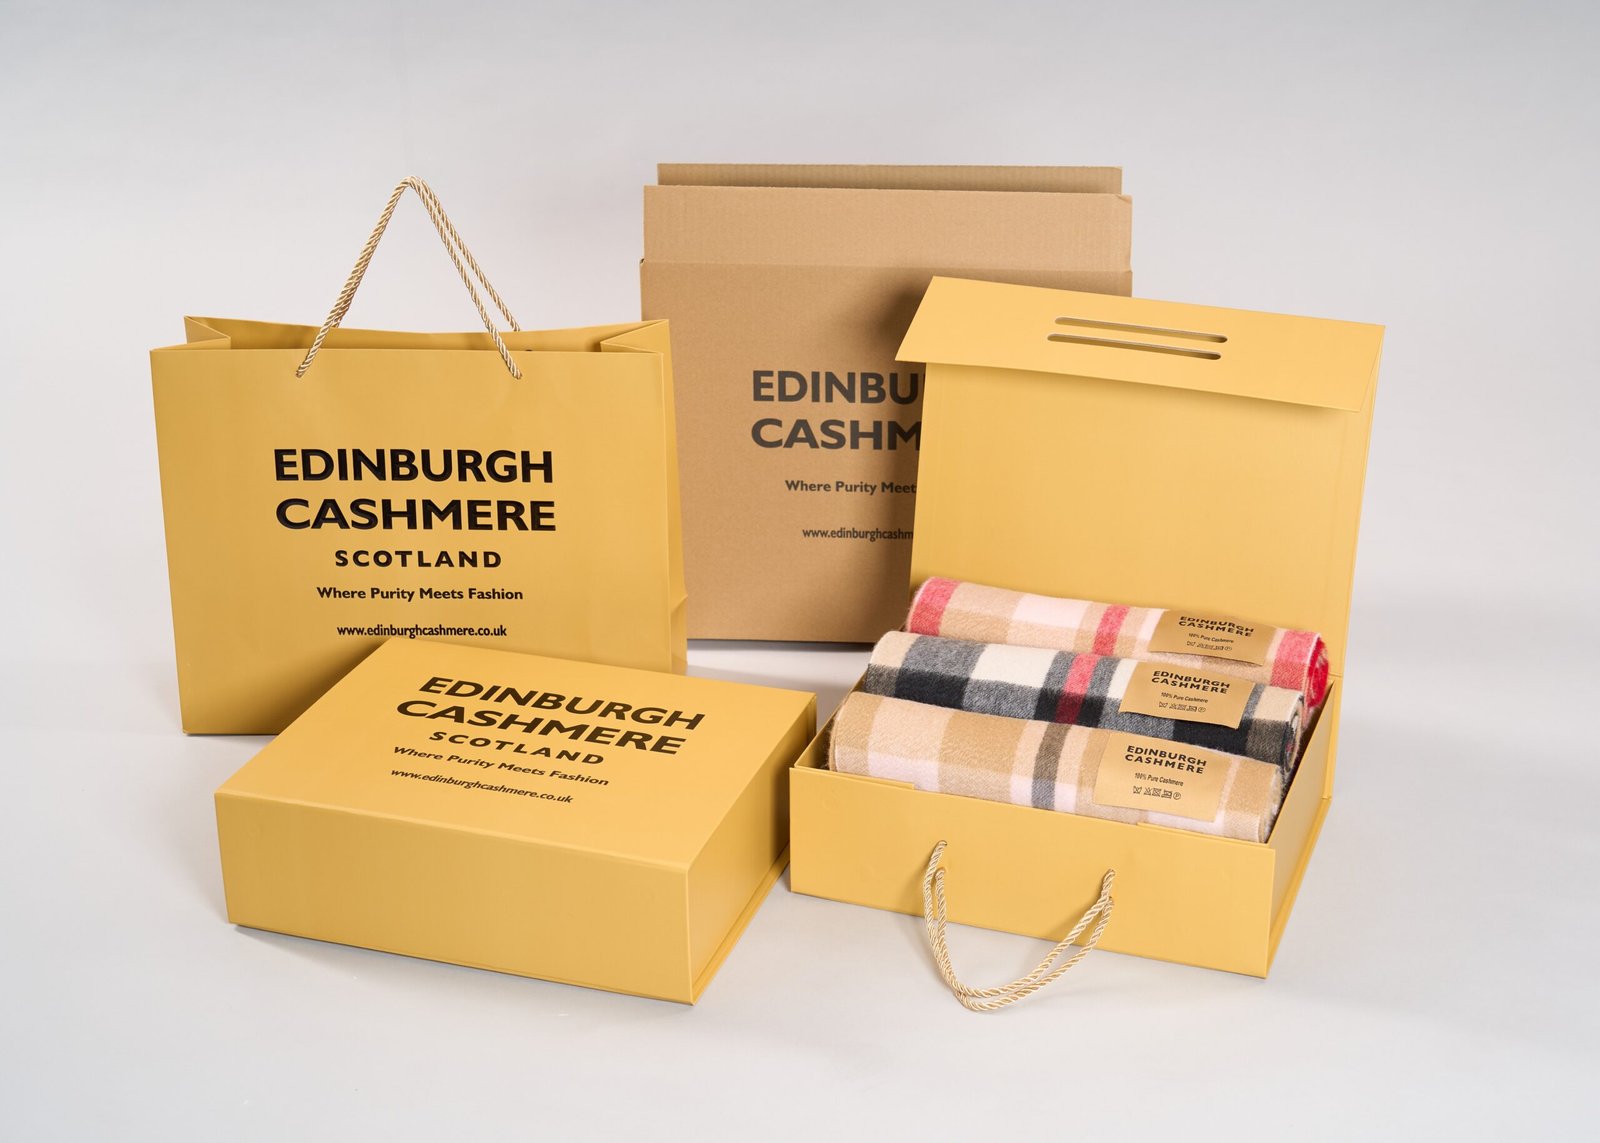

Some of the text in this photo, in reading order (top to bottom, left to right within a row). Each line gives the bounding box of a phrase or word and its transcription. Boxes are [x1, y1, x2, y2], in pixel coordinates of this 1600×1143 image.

[752, 370, 925, 406] EDINBU
[751, 418, 922, 451] CASHM
[274, 448, 553, 483] EDINBURGH
[785, 480, 917, 496] Where Purity Meet
[275, 498, 556, 532] CASHMERE
[335, 550, 502, 568] SCOTLAND
[317, 587, 523, 602] Where Purity Meets Fashion
[337, 624, 507, 639] www.edinburghcashmere.co.uk
[1178, 621, 1253, 637] CASHMERE
[1179, 616, 1254, 633] EDINBURGH
[1200, 634, 1211, 642] Pure
[1211, 636, 1234, 644] Cashmere
[1151, 677, 1228, 694] CASHMERE
[1153, 670, 1230, 689] EDINBURGH
[418, 676, 705, 730] EDINBURGH
[1184, 695, 1208, 704] Cashmere
[396, 700, 686, 755] CASHMERE
[429, 731, 604, 765] SCOTLAND
[1126, 745, 1207, 767] EDINBURGH
[393, 746, 609, 786] Where Purity Meets Fashion
[1125, 754, 1205, 774] CASHMERE
[391, 769, 573, 804] www.edinburghcashmere.co.uk
[1134, 772, 1184, 787] 100% Pure Cashmere
